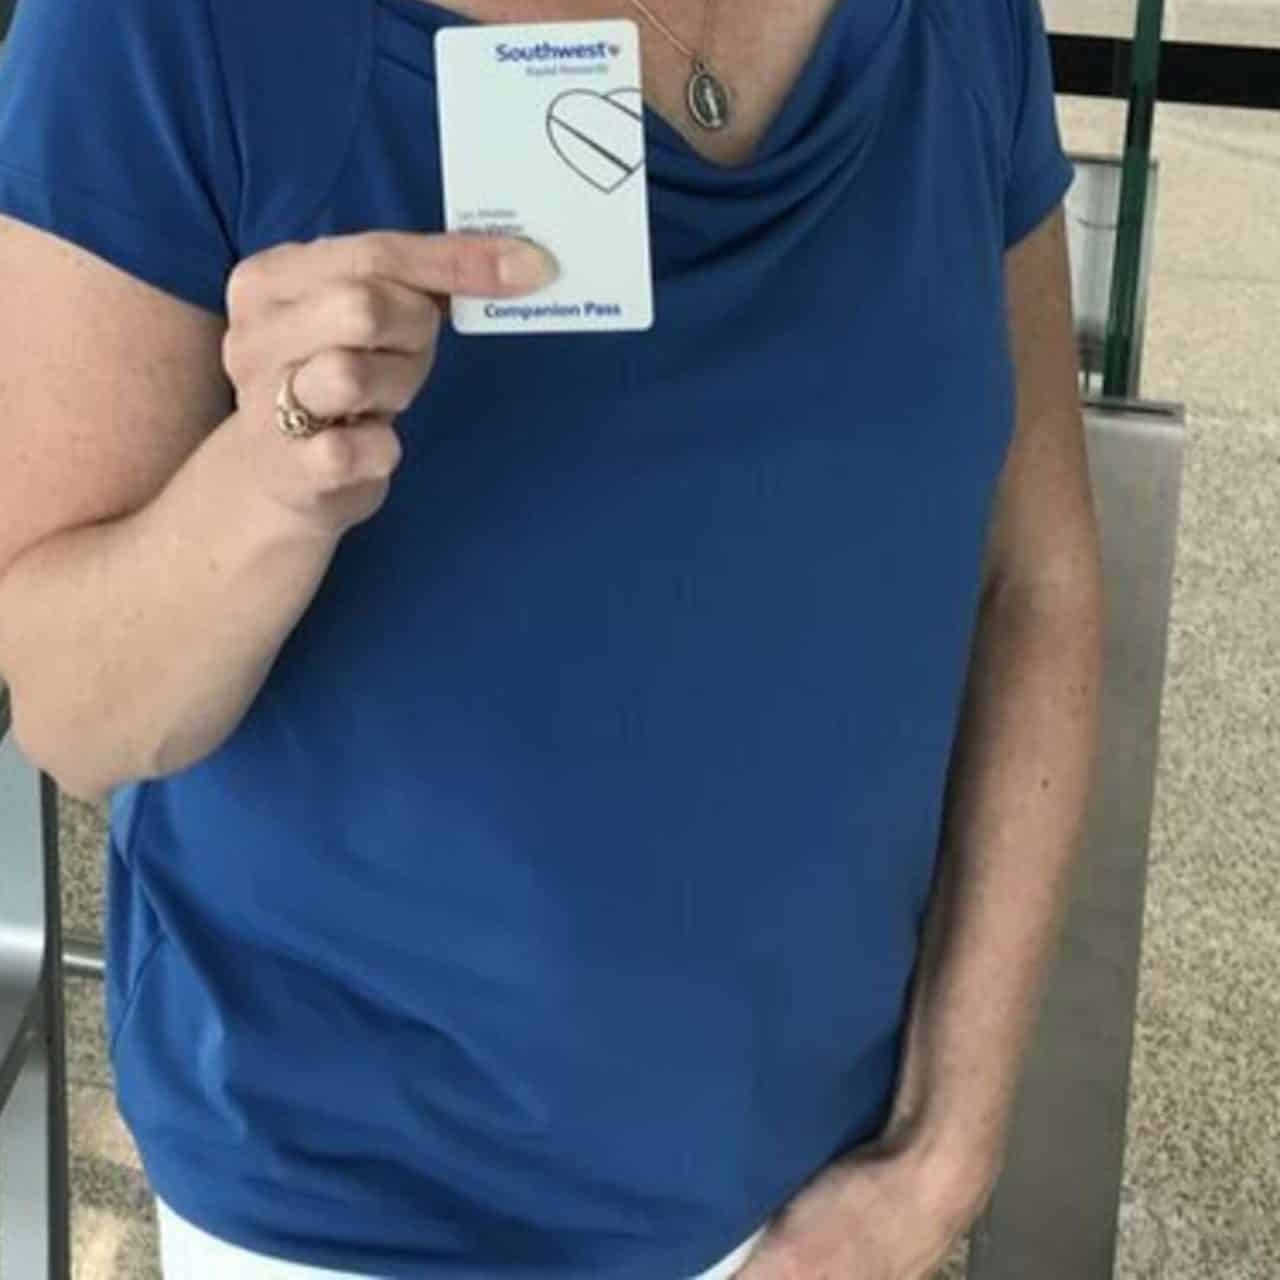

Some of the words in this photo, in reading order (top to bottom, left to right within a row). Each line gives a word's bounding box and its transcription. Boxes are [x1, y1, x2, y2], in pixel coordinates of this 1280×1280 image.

[495, 40, 607, 62] Southwest
[484, 302, 581, 320] Companion
[584, 300, 621, 316] Pass
